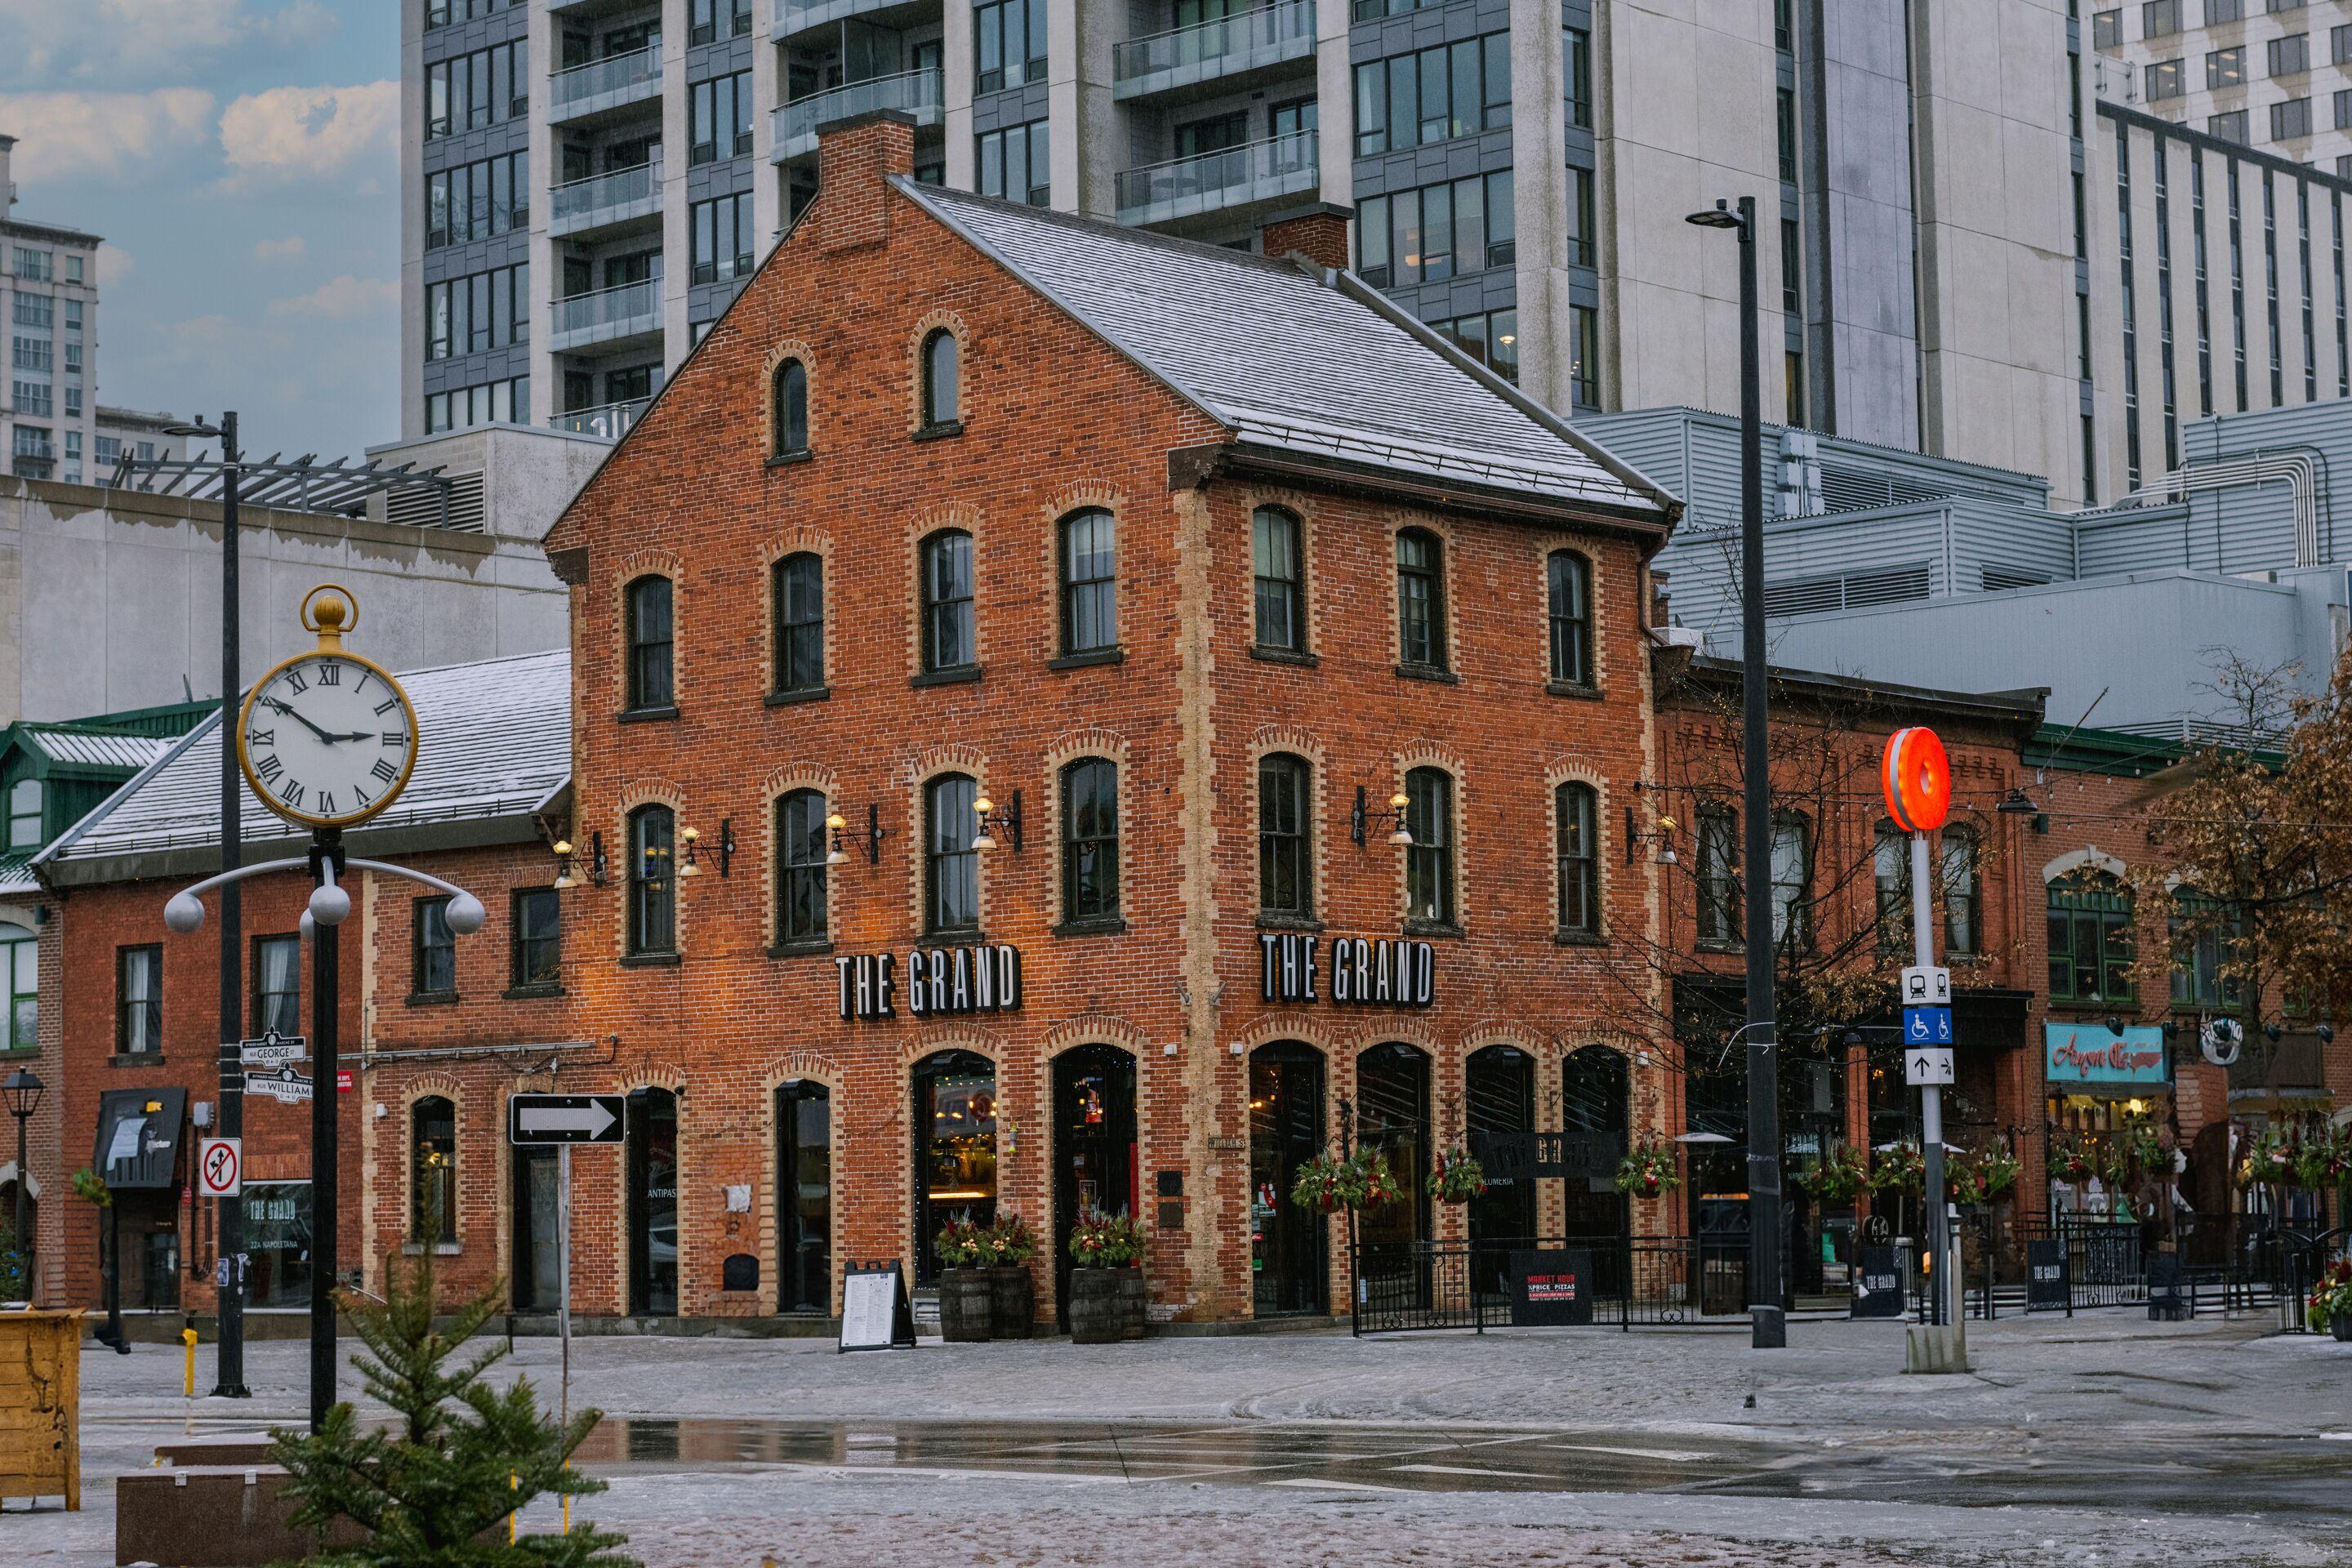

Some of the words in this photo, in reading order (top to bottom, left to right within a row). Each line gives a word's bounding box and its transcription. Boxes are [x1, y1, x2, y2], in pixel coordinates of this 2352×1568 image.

[285, 670, 310, 696] XI
[318, 665, 341, 686] XII
[354, 675, 368, 693] I
[373, 698, 396, 717] II
[252, 728, 274, 746] IX
[382, 732, 403, 747] III
[256, 753, 284, 786] VIII
[280, 779, 305, 807] VII
[318, 791, 336, 813] VI
[354, 785, 370, 805] V
[1261, 934, 1316, 1000] THE
[1332, 938, 1433, 1005] GRAND
[835, 953, 892, 1018] THE
[908, 944, 1018, 1014] GRAND
[257, 1048, 289, 1058] GEORGE
[268, 1082, 310, 1095] WILLIAM
[648, 1188, 676, 1198] ANTIPAS
[250, 1200, 265, 1219] THE
[268, 1199, 296, 1219] GRAND
[263, 1241, 298, 1249] NAPOLETANA
[1528, 1275, 1555, 1283] MARKET
[1557, 1274, 1575, 1283] HOUR
